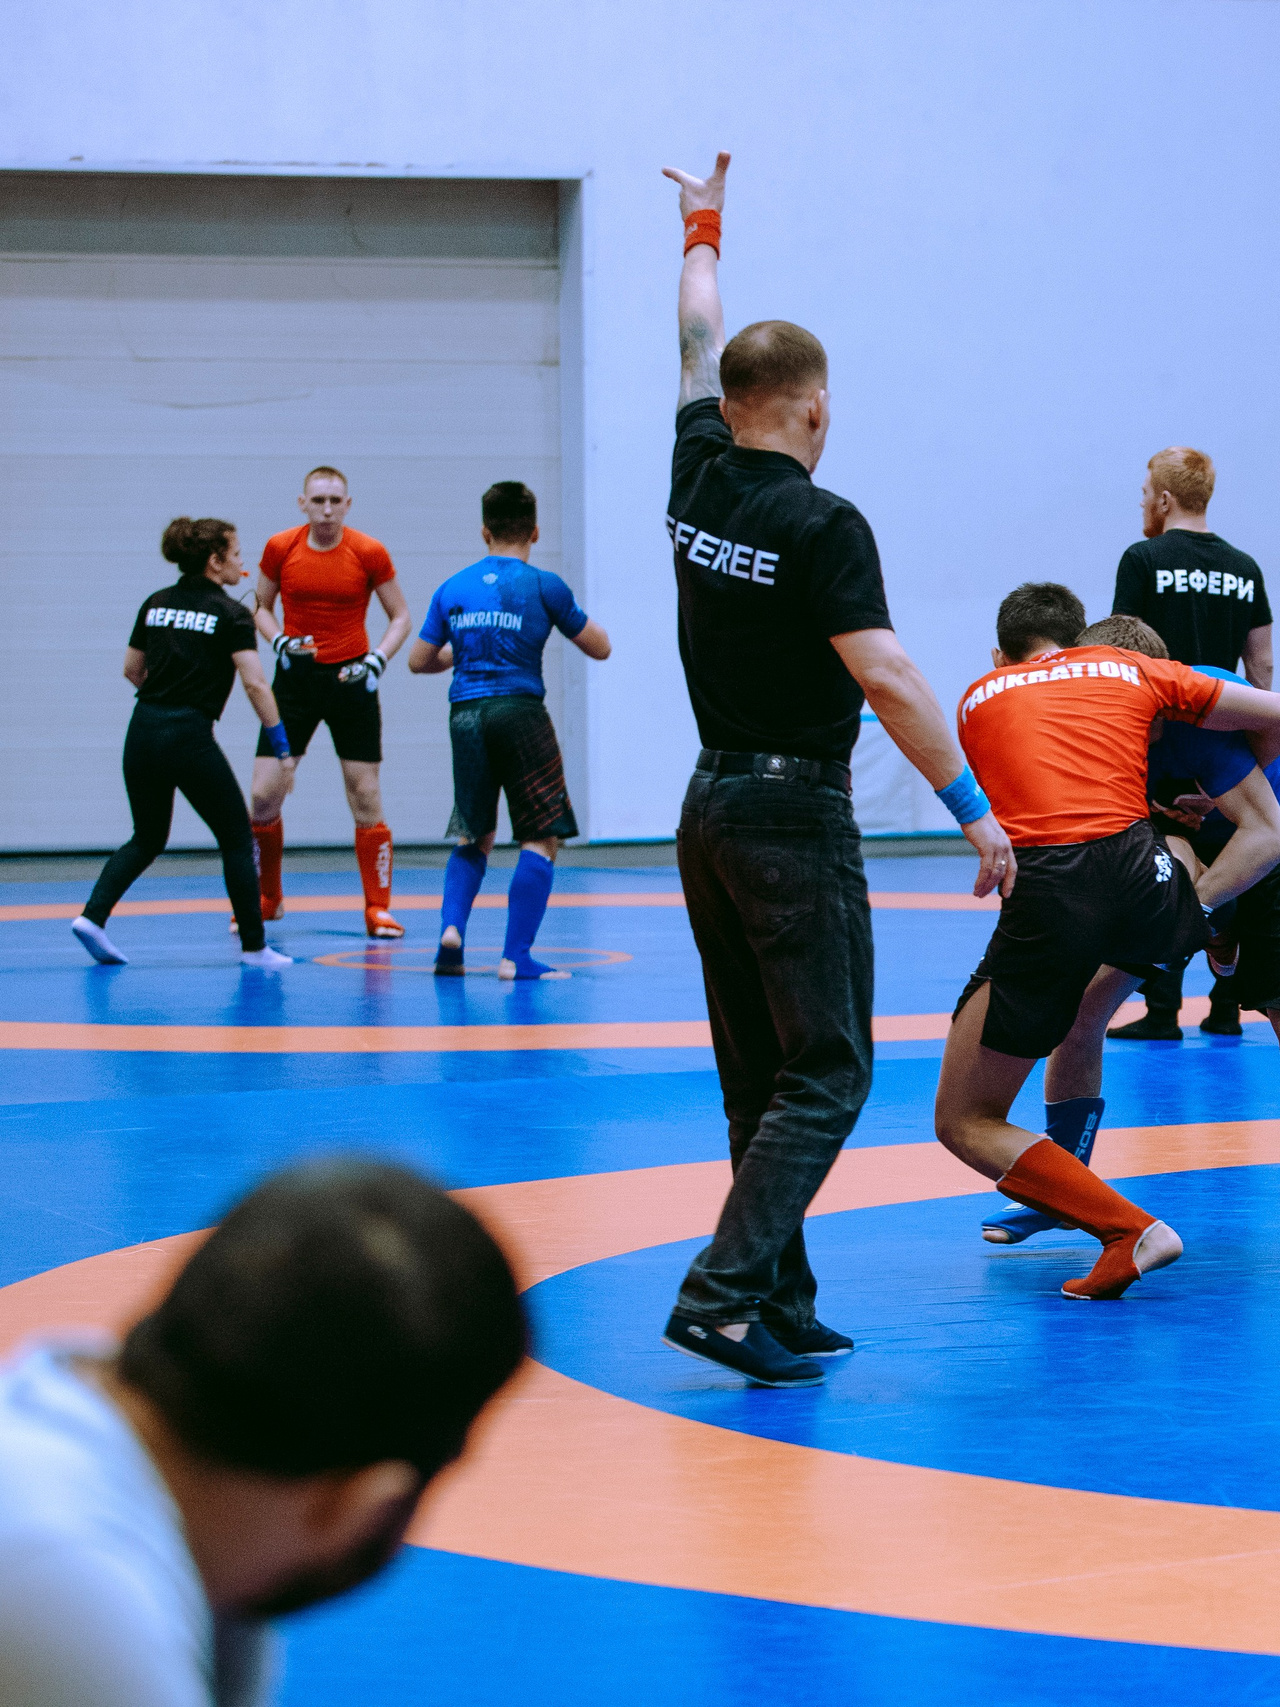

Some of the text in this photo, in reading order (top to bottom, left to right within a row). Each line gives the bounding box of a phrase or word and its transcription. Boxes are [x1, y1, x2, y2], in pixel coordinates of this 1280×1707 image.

[1156, 569, 1255, 603] РЕФЕРИ
[146, 607, 219, 634] REFEREE
[450, 611, 522, 632] PANKRATION
